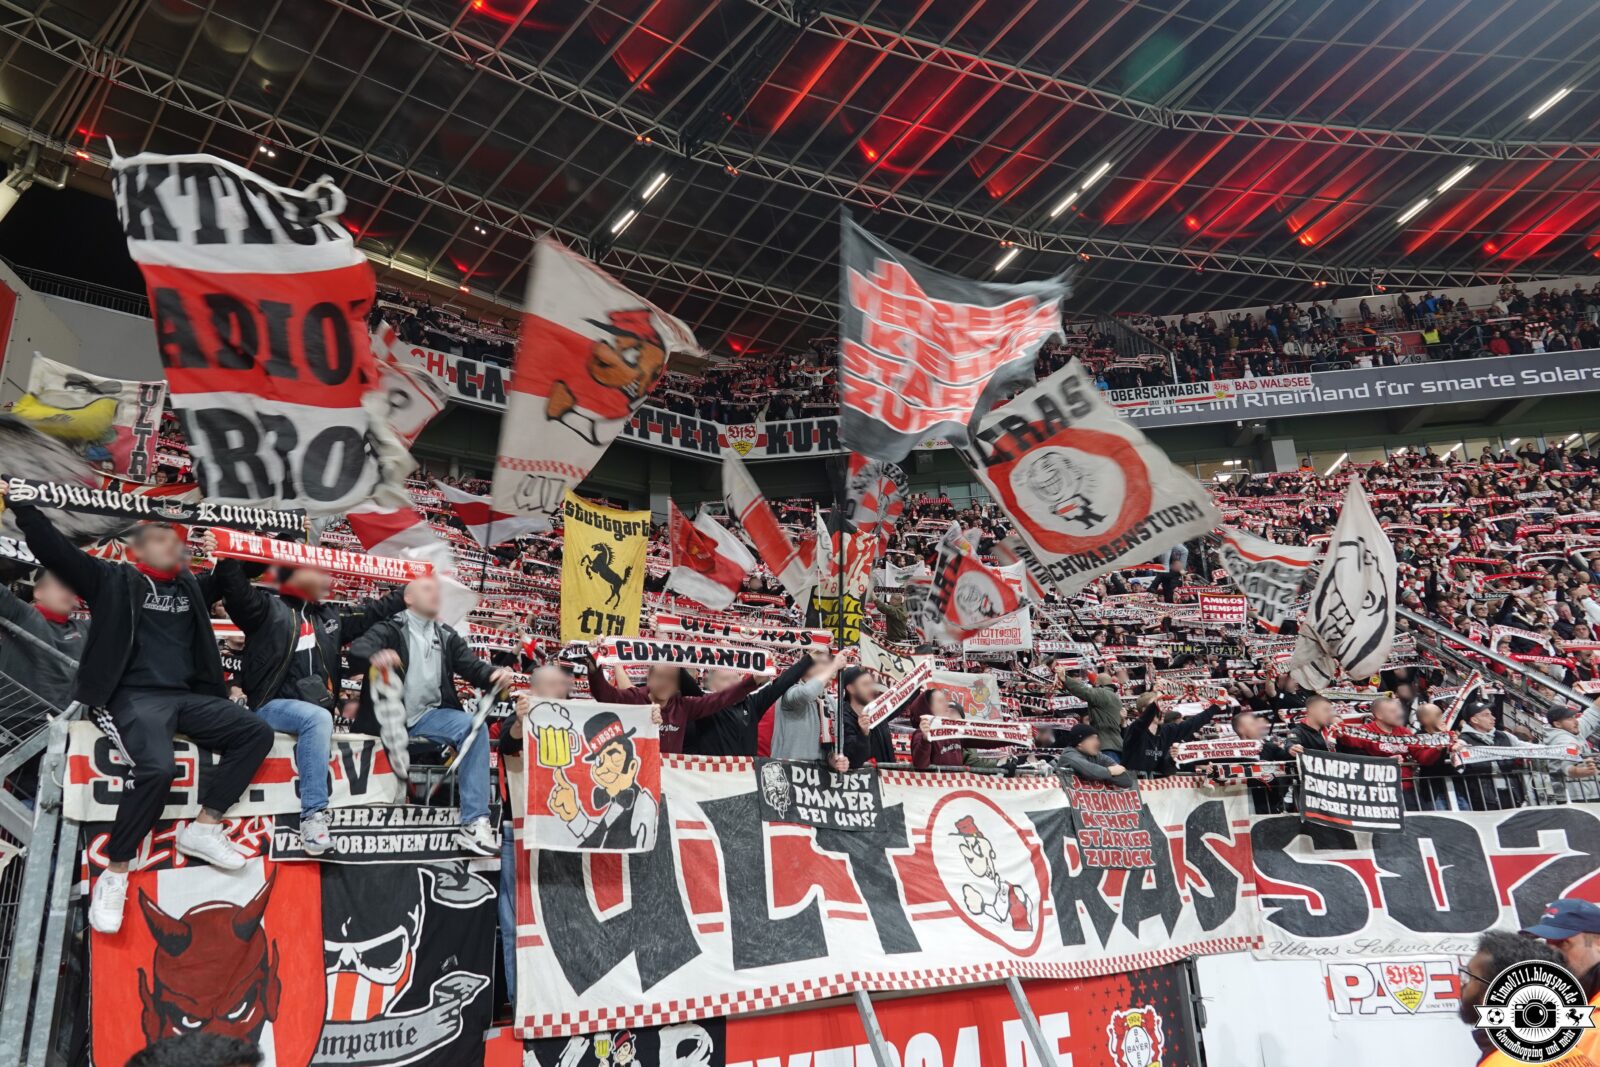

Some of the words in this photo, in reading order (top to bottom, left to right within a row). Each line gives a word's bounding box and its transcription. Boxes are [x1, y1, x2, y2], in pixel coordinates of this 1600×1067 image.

[1110, 383, 1209, 402] OBERSCHWABEN
[1234, 380, 1258, 391] BAD
[1261, 376, 1311, 389] WALDSEE
[1244, 382, 1370, 409] Rheinland
[1375, 379, 1415, 397] für
[1421, 372, 1517, 394] smarte
[766, 419, 842, 455] KUR
[1046, 499, 1207, 584] CHWABENSTURM
[271, 538, 303, 557] KEIN
[305, 545, 333, 561] WEG
[335, 549, 357, 565] IST
[358, 553, 375, 567] ZU
[376, 556, 407, 572] WEIT
[298, 556, 318, 565] MAN
[333, 561, 349, 571] MIT
[349, 562, 391, 577] FREUNDEN
[1202, 596, 1245, 604] AMIGOS
[578, 606, 626, 637] CITY
[615, 639, 767, 673] COMMANDO
[791, 765, 821, 786] DU
[1302, 753, 1361, 780] KAMPF
[1363, 763, 1398, 783] UND
[793, 784, 875, 811] IMMER
[1066, 787, 1143, 812] VERBANNTE
[1304, 774, 1367, 801] EINSATZ
[796, 806, 828, 823] BEI
[834, 812, 878, 828] UNS!
[1080, 810, 1140, 829] KEHRT
[1305, 795, 1349, 816] UNSERE
[1350, 803, 1400, 819] FARBEN!
[1083, 847, 1156, 868] ZURÜCK
[1269, 940, 1340, 957] Ultras
[1346, 937, 1481, 955] Schwabens
[316, 1023, 418, 1060] mpanie
[1126, 1042, 1148, 1054] BAYER
